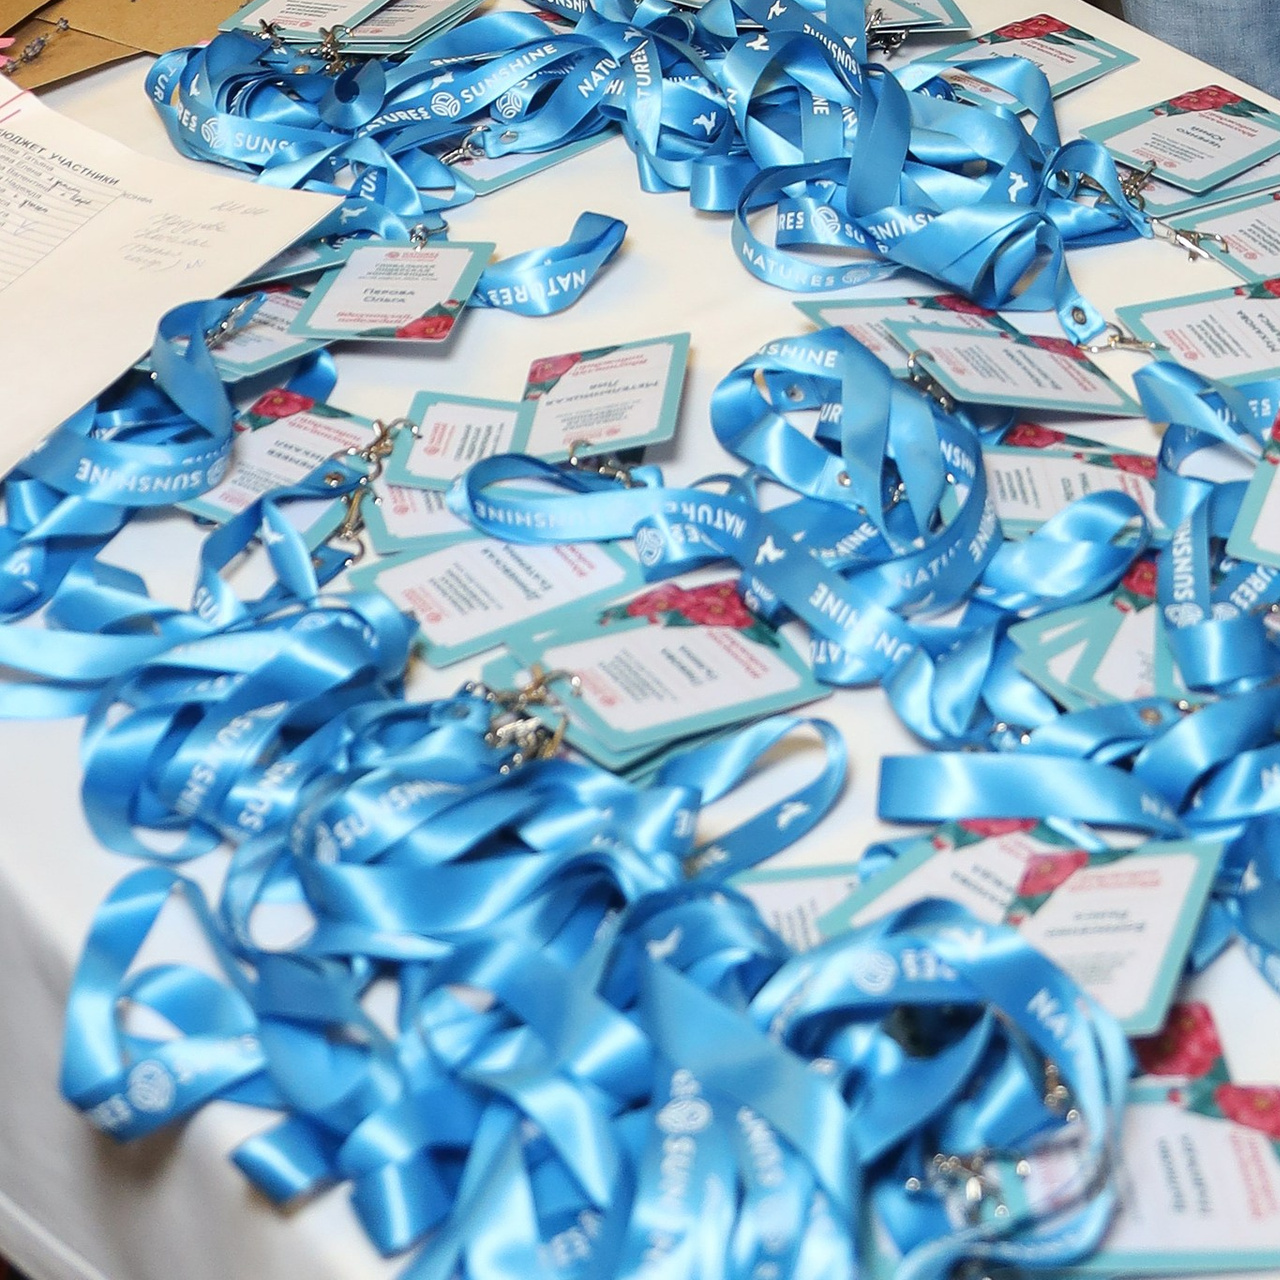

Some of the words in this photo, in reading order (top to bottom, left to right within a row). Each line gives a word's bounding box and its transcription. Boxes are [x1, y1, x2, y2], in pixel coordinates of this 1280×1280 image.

[460, 44, 558, 104] SUNSHINE
[1172, 127, 1224, 148] ЧЕРЕНКО
[1188, 126, 1226, 141] ЮРИЙ
[49, 152, 121, 186] УЧАСТНИКИ
[742, 242, 834, 287] NATURES
[75, 457, 203, 494] SUNSHINE
